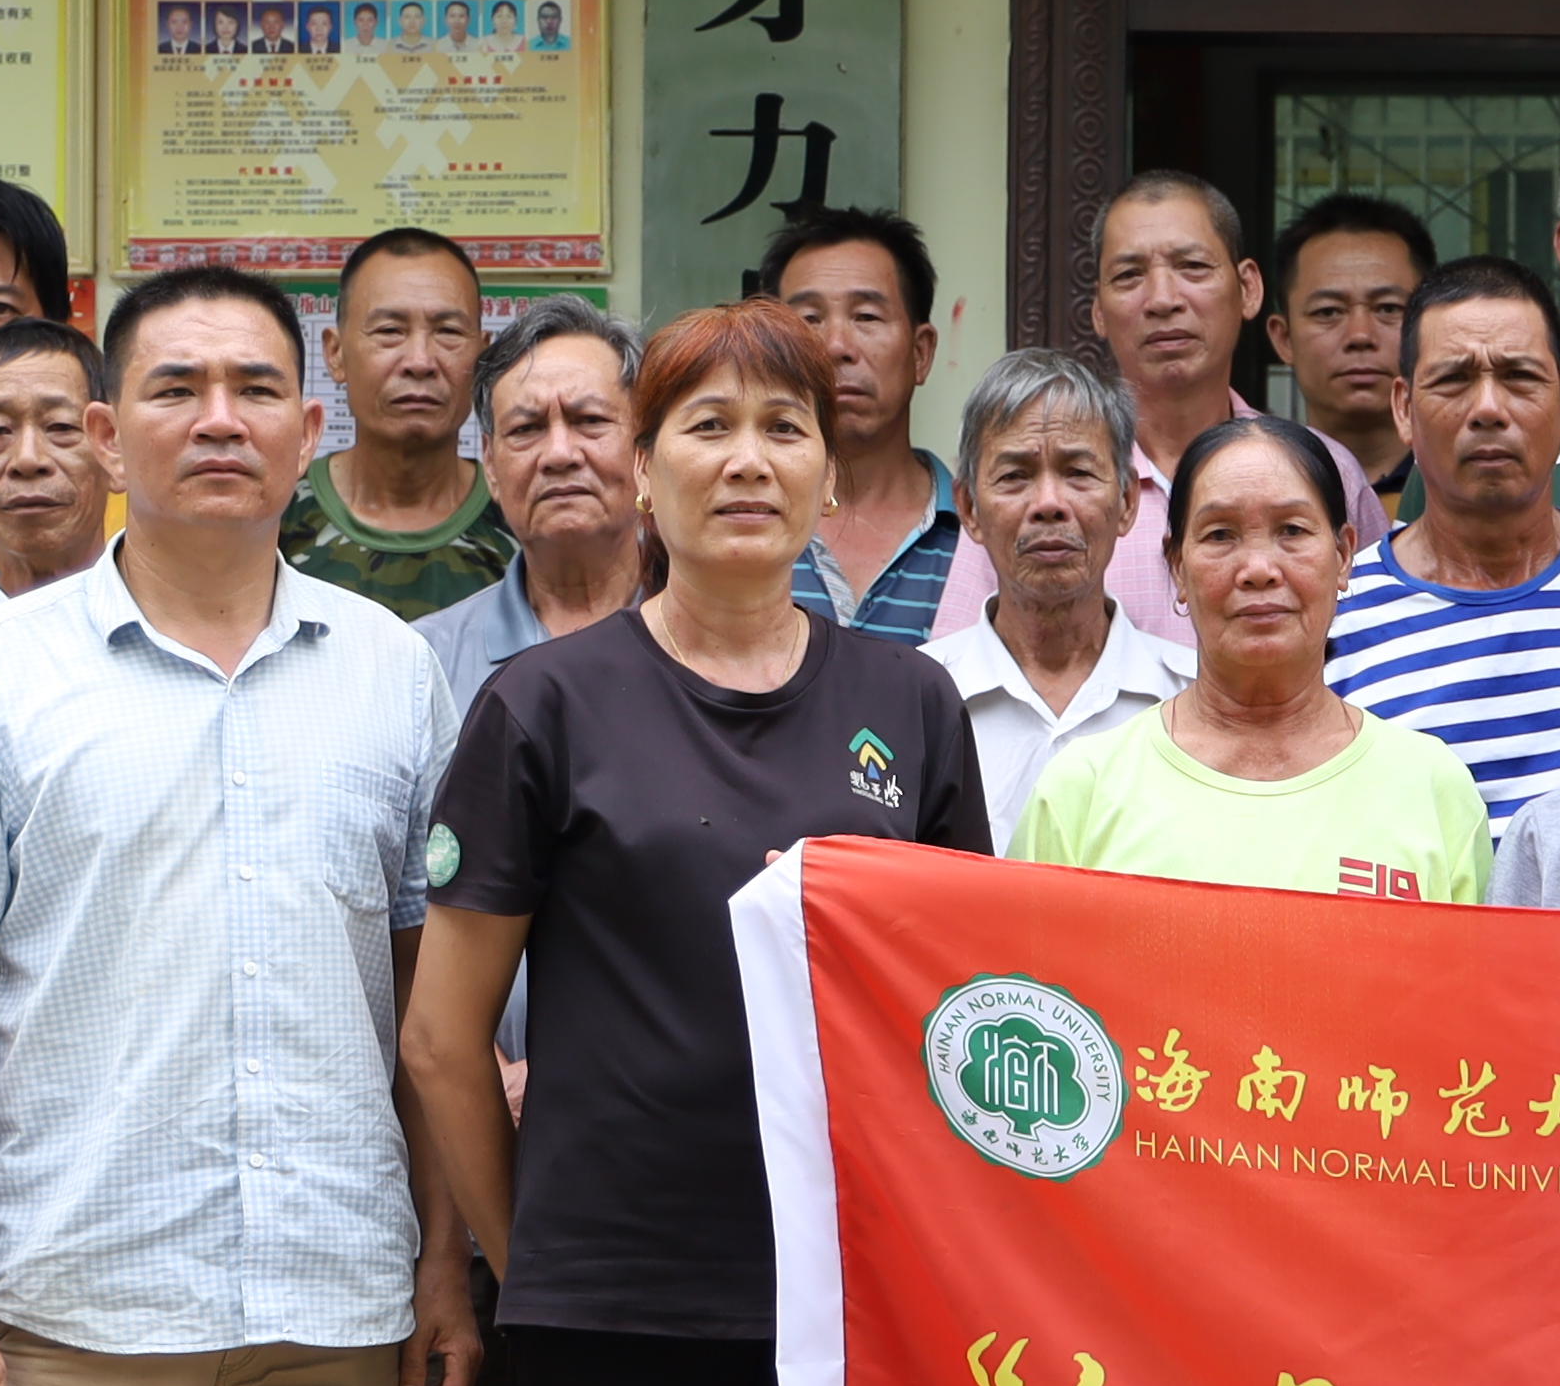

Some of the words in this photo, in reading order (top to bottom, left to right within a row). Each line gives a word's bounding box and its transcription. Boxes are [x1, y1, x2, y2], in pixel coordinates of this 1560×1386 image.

[939, 1009, 967, 1074] HAINAN
[968, 991, 1045, 1014] NORMAL
[1052, 1005, 1111, 1102] UNIVERSITY
[1134, 1130, 1281, 1171] HAINAN
[1293, 1147, 1456, 1188] NORMAL
